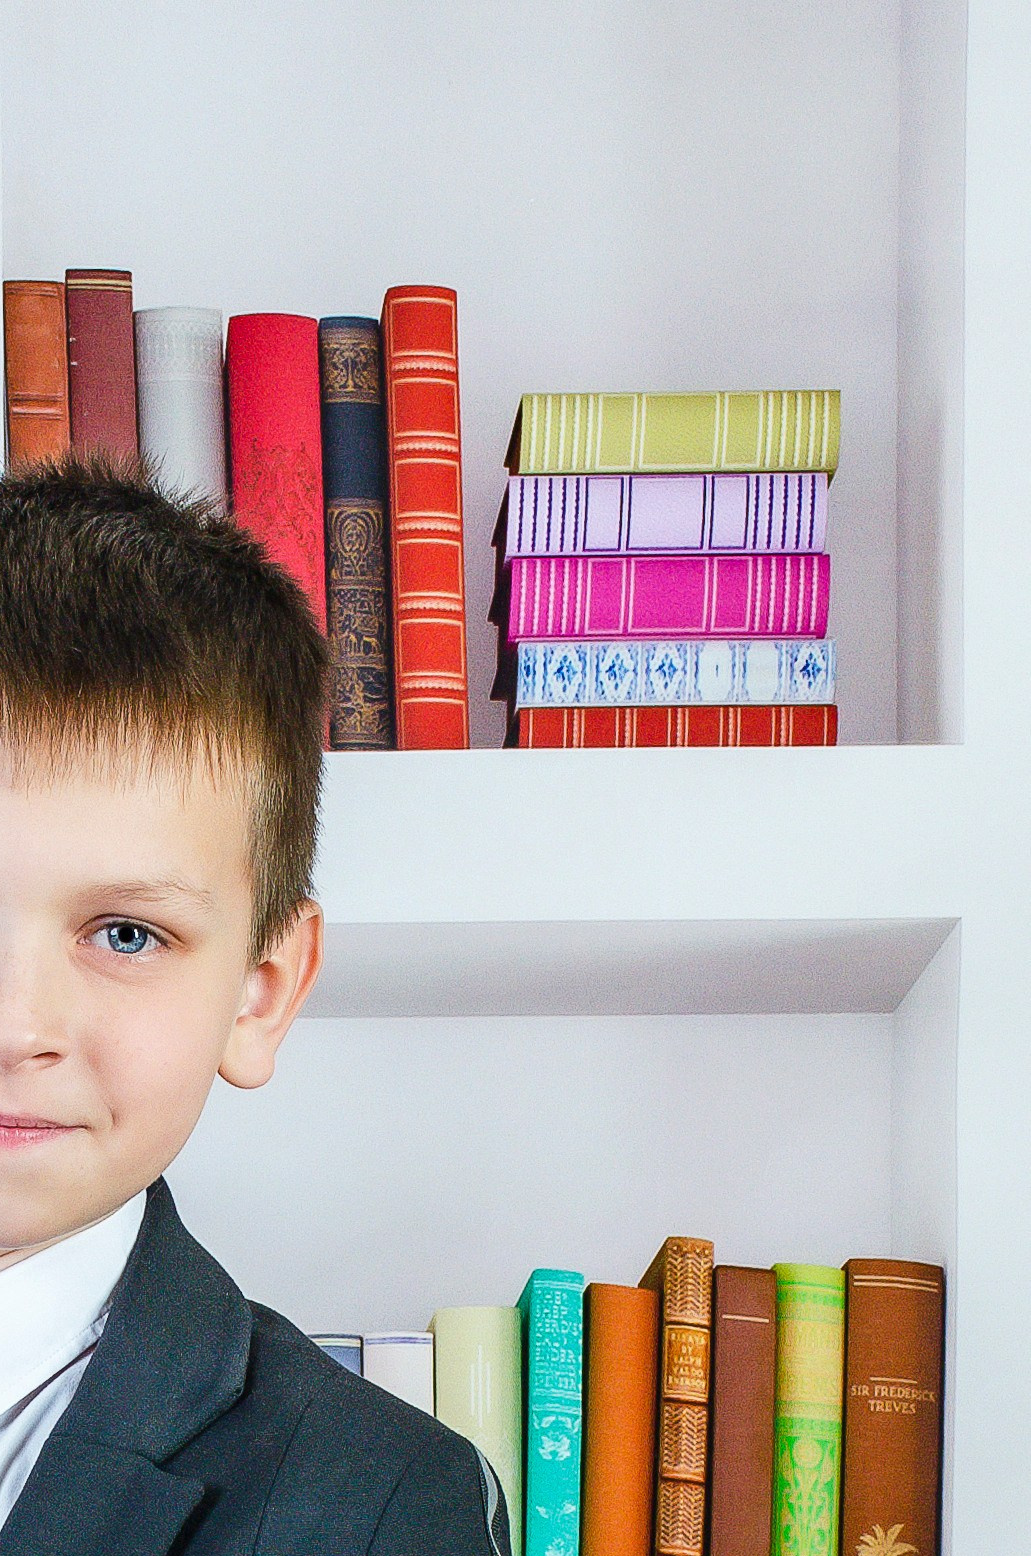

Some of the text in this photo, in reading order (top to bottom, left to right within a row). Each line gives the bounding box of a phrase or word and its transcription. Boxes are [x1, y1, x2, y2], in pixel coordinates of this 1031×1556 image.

[851, 1385, 937, 1402] SIR FREDERICK
[868, 1399, 917, 1415] TREVES
